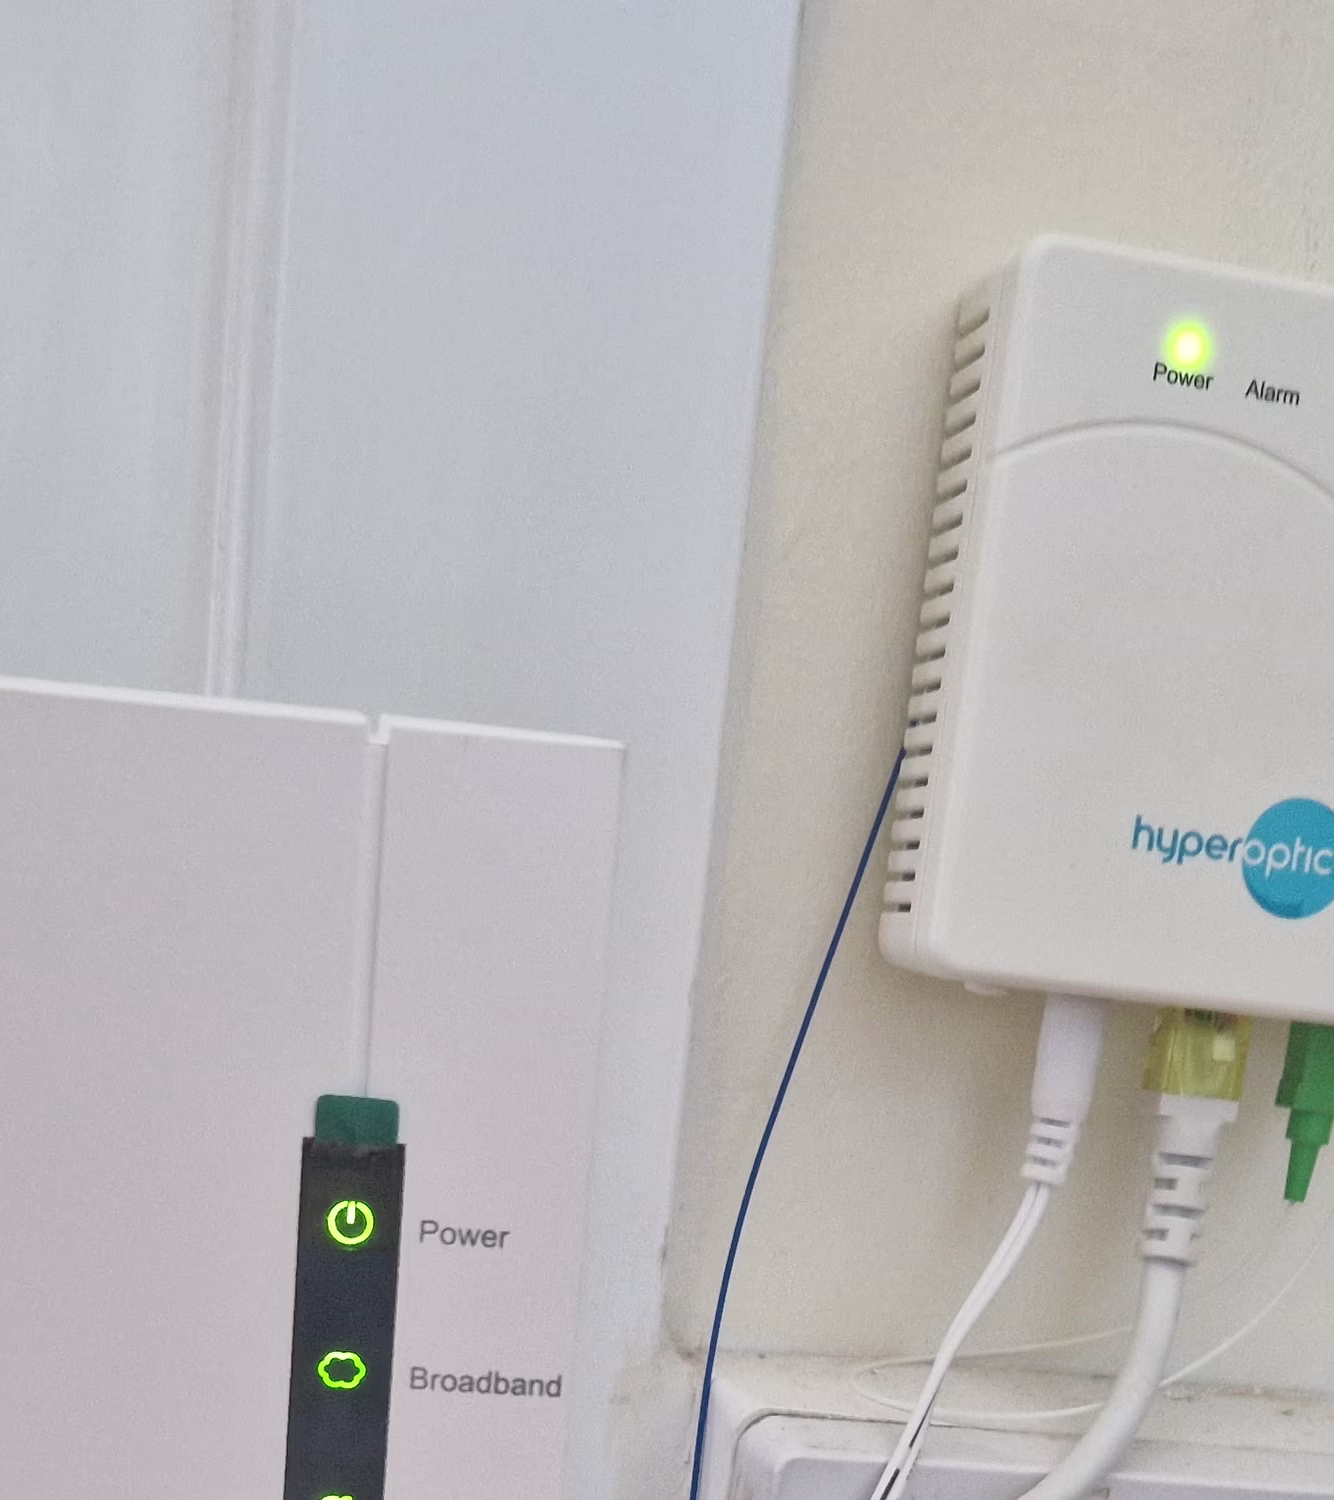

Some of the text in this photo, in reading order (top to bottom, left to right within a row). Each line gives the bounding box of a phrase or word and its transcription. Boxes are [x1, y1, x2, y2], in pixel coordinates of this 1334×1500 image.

[1152, 361, 1214, 391] Power
[1245, 379, 1301, 406] Alarm
[1131, 814, 1334, 878] hyperoptic
[419, 1220, 510, 1248] Power
[410, 1367, 563, 1398] Broadband
